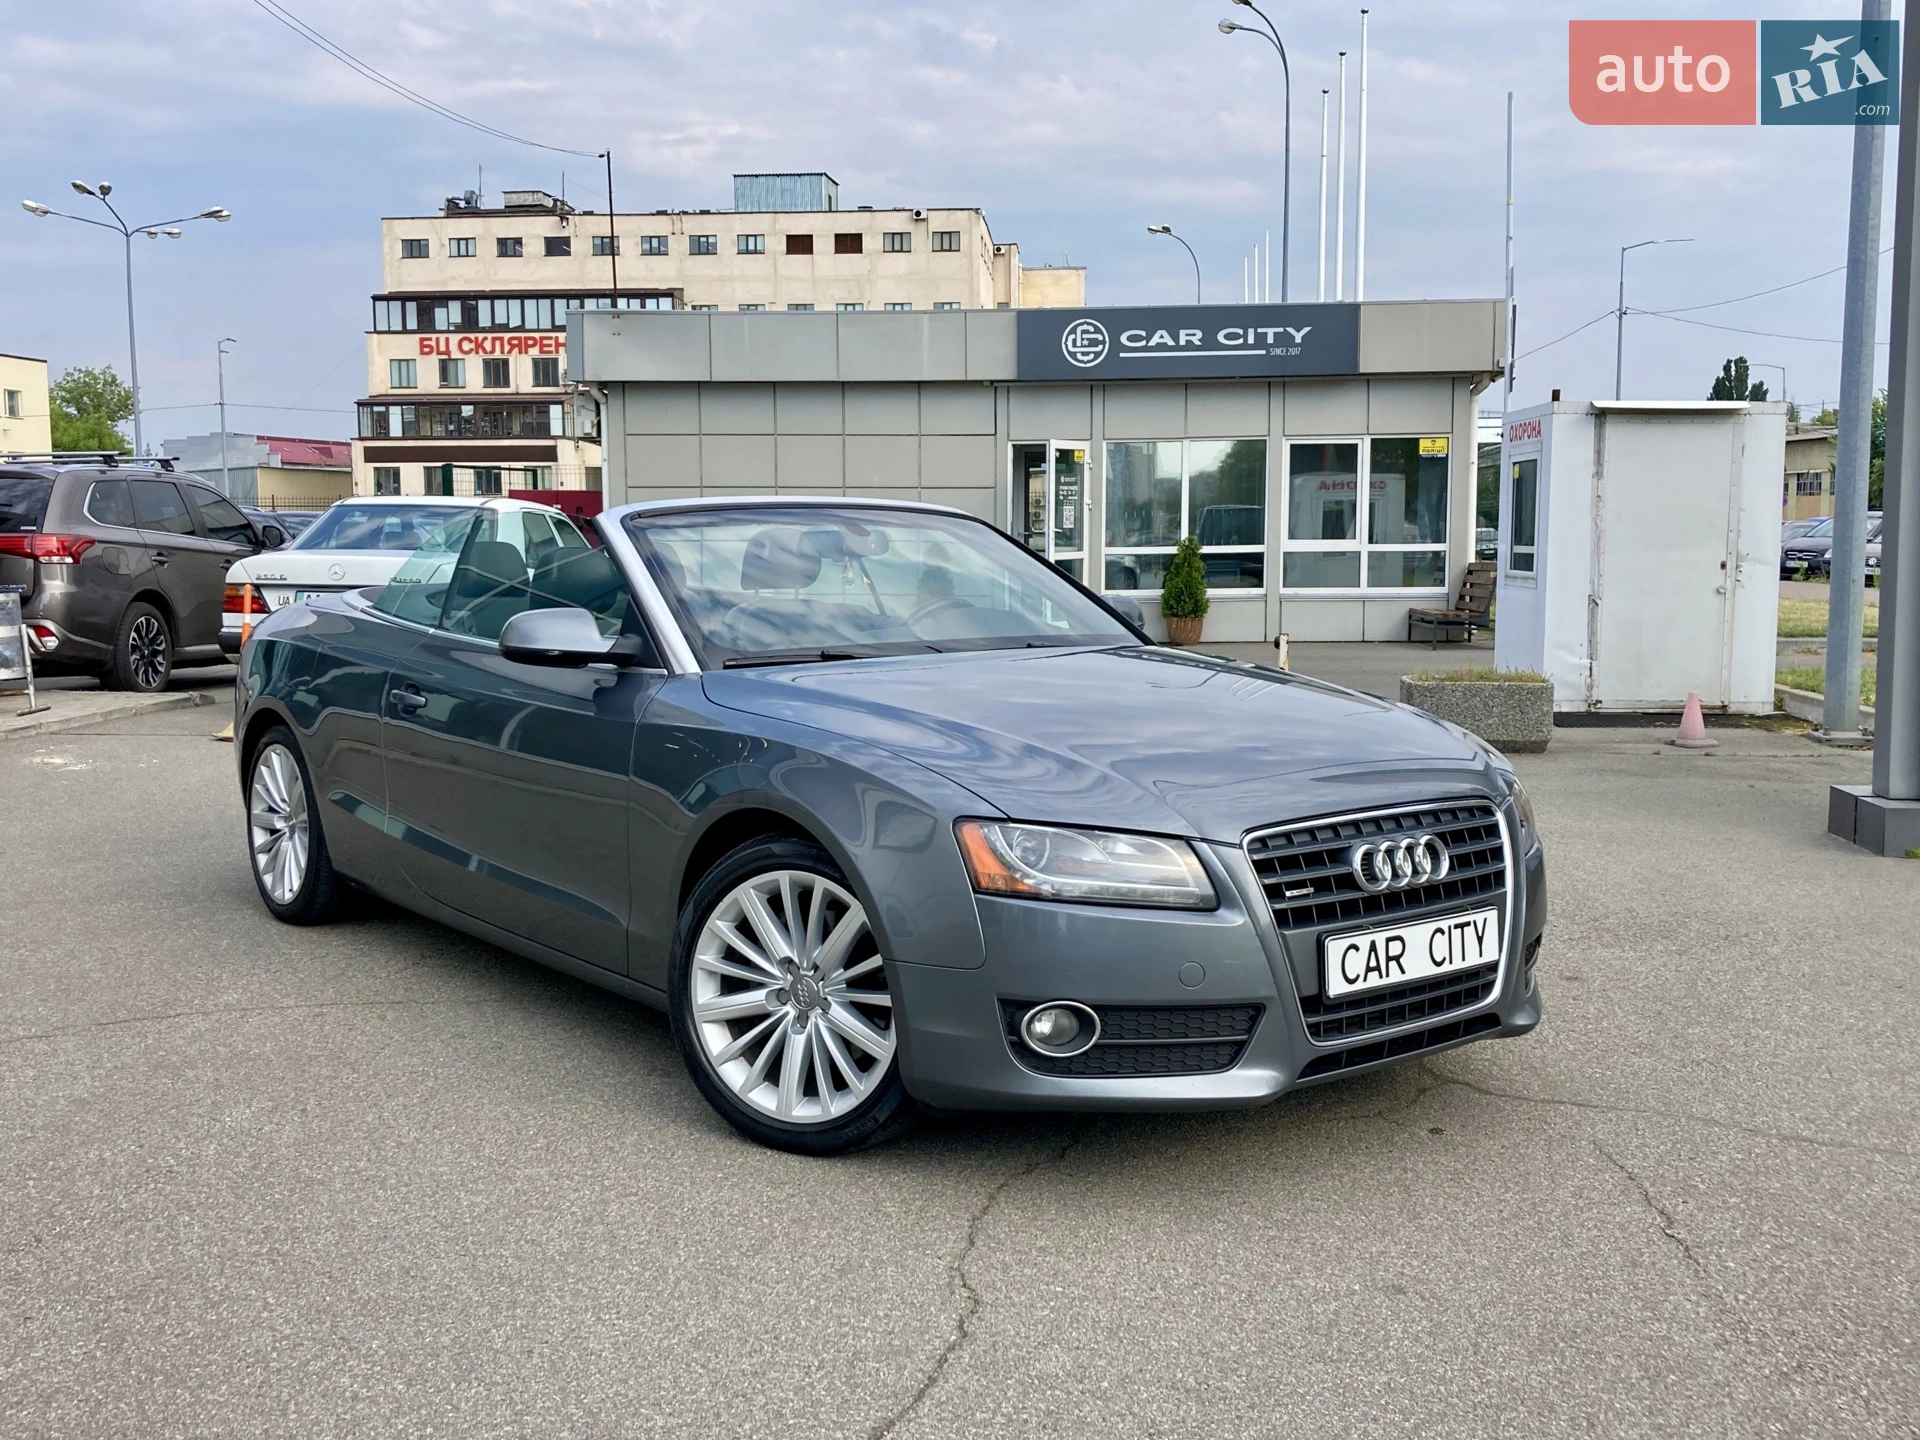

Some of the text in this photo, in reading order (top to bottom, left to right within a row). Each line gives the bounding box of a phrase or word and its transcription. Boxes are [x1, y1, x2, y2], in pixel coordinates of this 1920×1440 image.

[419, 335, 566, 359] БЦ СКЛЯРЕН
[1119, 326, 1313, 347] CAR CITY
[1269, 347, 1302, 356] SINCE 2017
[1509, 419, 1542, 443] ОХОРОНА
[277, 595, 291, 606] UA
[1340, 916, 1488, 985] CAR CITY
